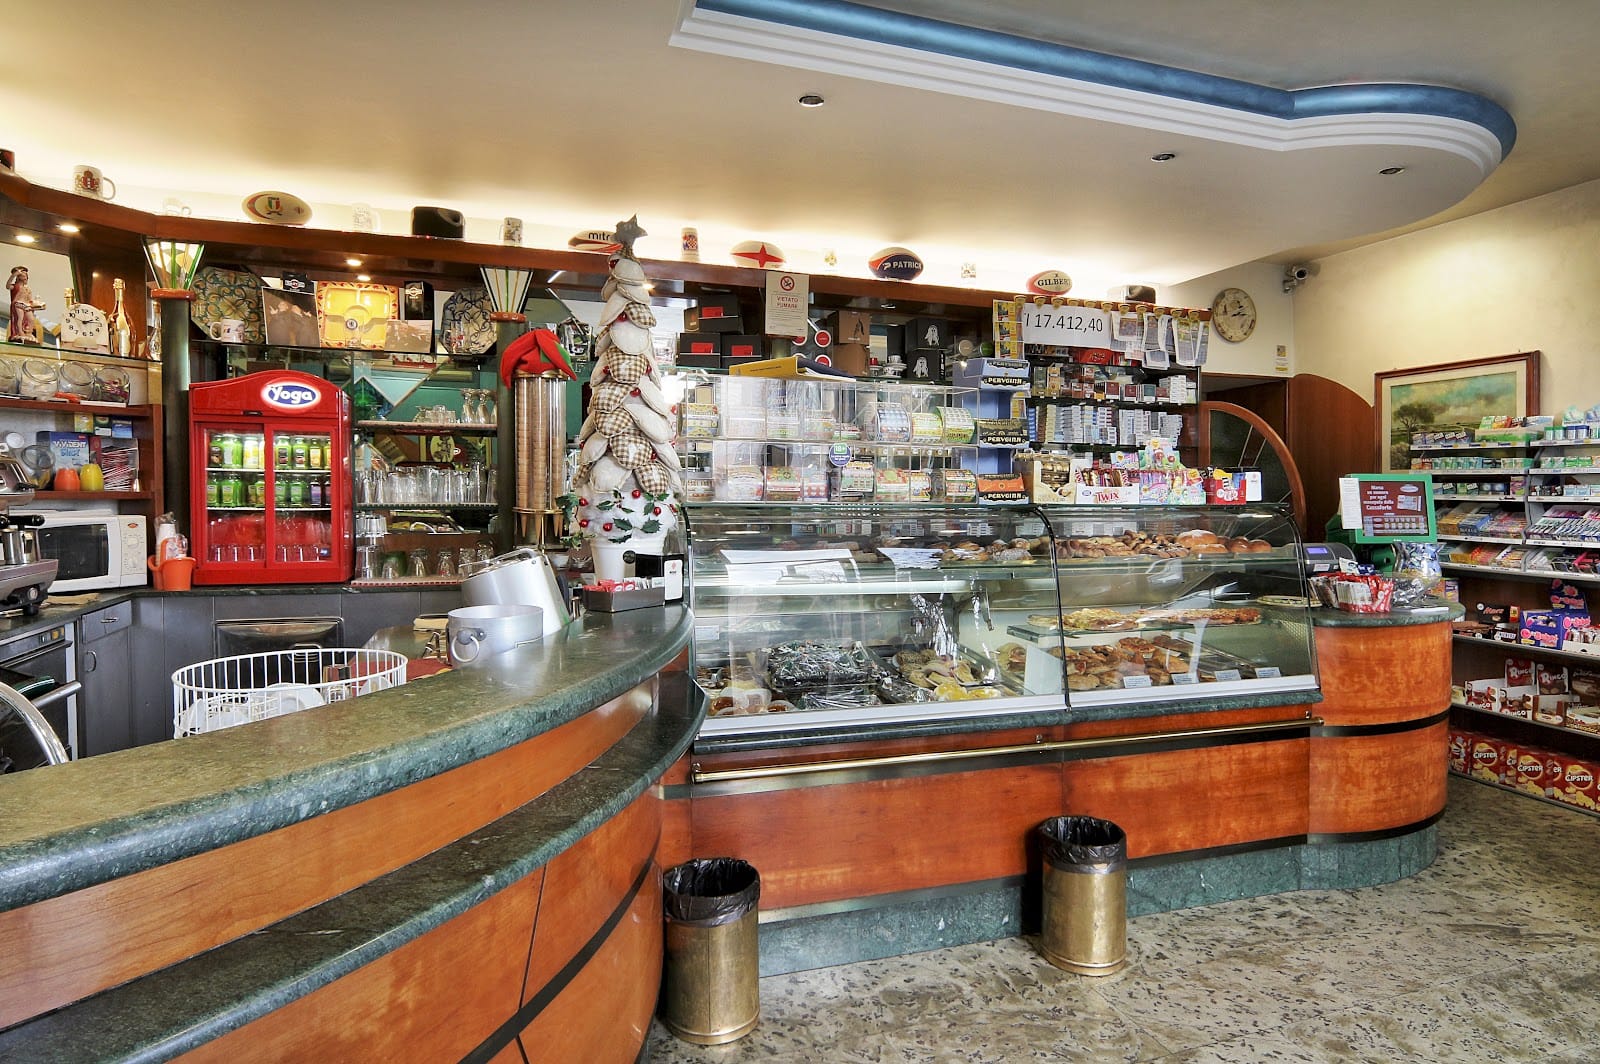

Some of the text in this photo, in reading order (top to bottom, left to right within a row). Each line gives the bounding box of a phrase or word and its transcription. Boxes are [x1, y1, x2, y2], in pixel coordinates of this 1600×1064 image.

[588, 232, 610, 241] mitr
[892, 260, 922, 269] PATRICK
[1034, 313, 1104, 333] 17.412,40
[269, 385, 313, 404] Yoga
